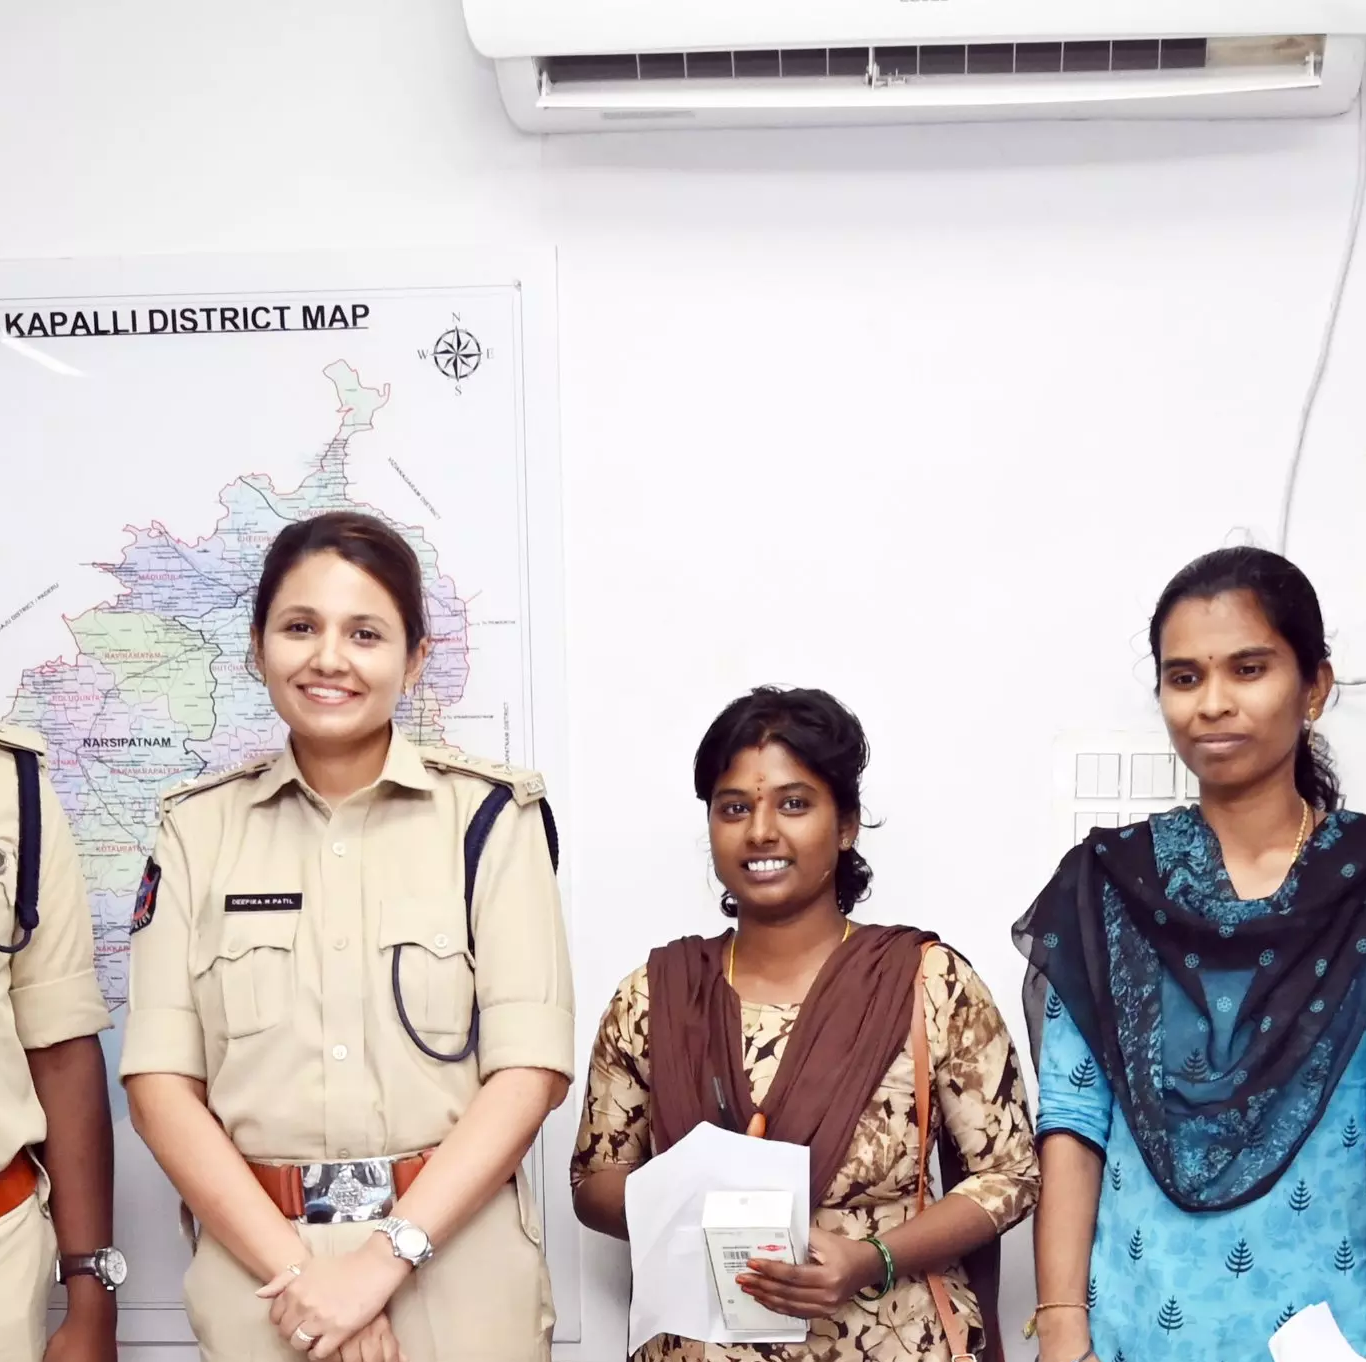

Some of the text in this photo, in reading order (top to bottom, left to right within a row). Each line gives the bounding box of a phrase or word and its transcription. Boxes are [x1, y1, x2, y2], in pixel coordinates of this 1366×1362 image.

[148, 306, 290, 333] DISTRICT
[302, 304, 370, 330] MAP
[452, 311, 461, 323] N
[417, 349, 429, 360] W
[454, 385, 463, 397] S
[10, 600, 35, 621] DISTRICT
[83, 737, 172, 748] NARSIPATNAM
